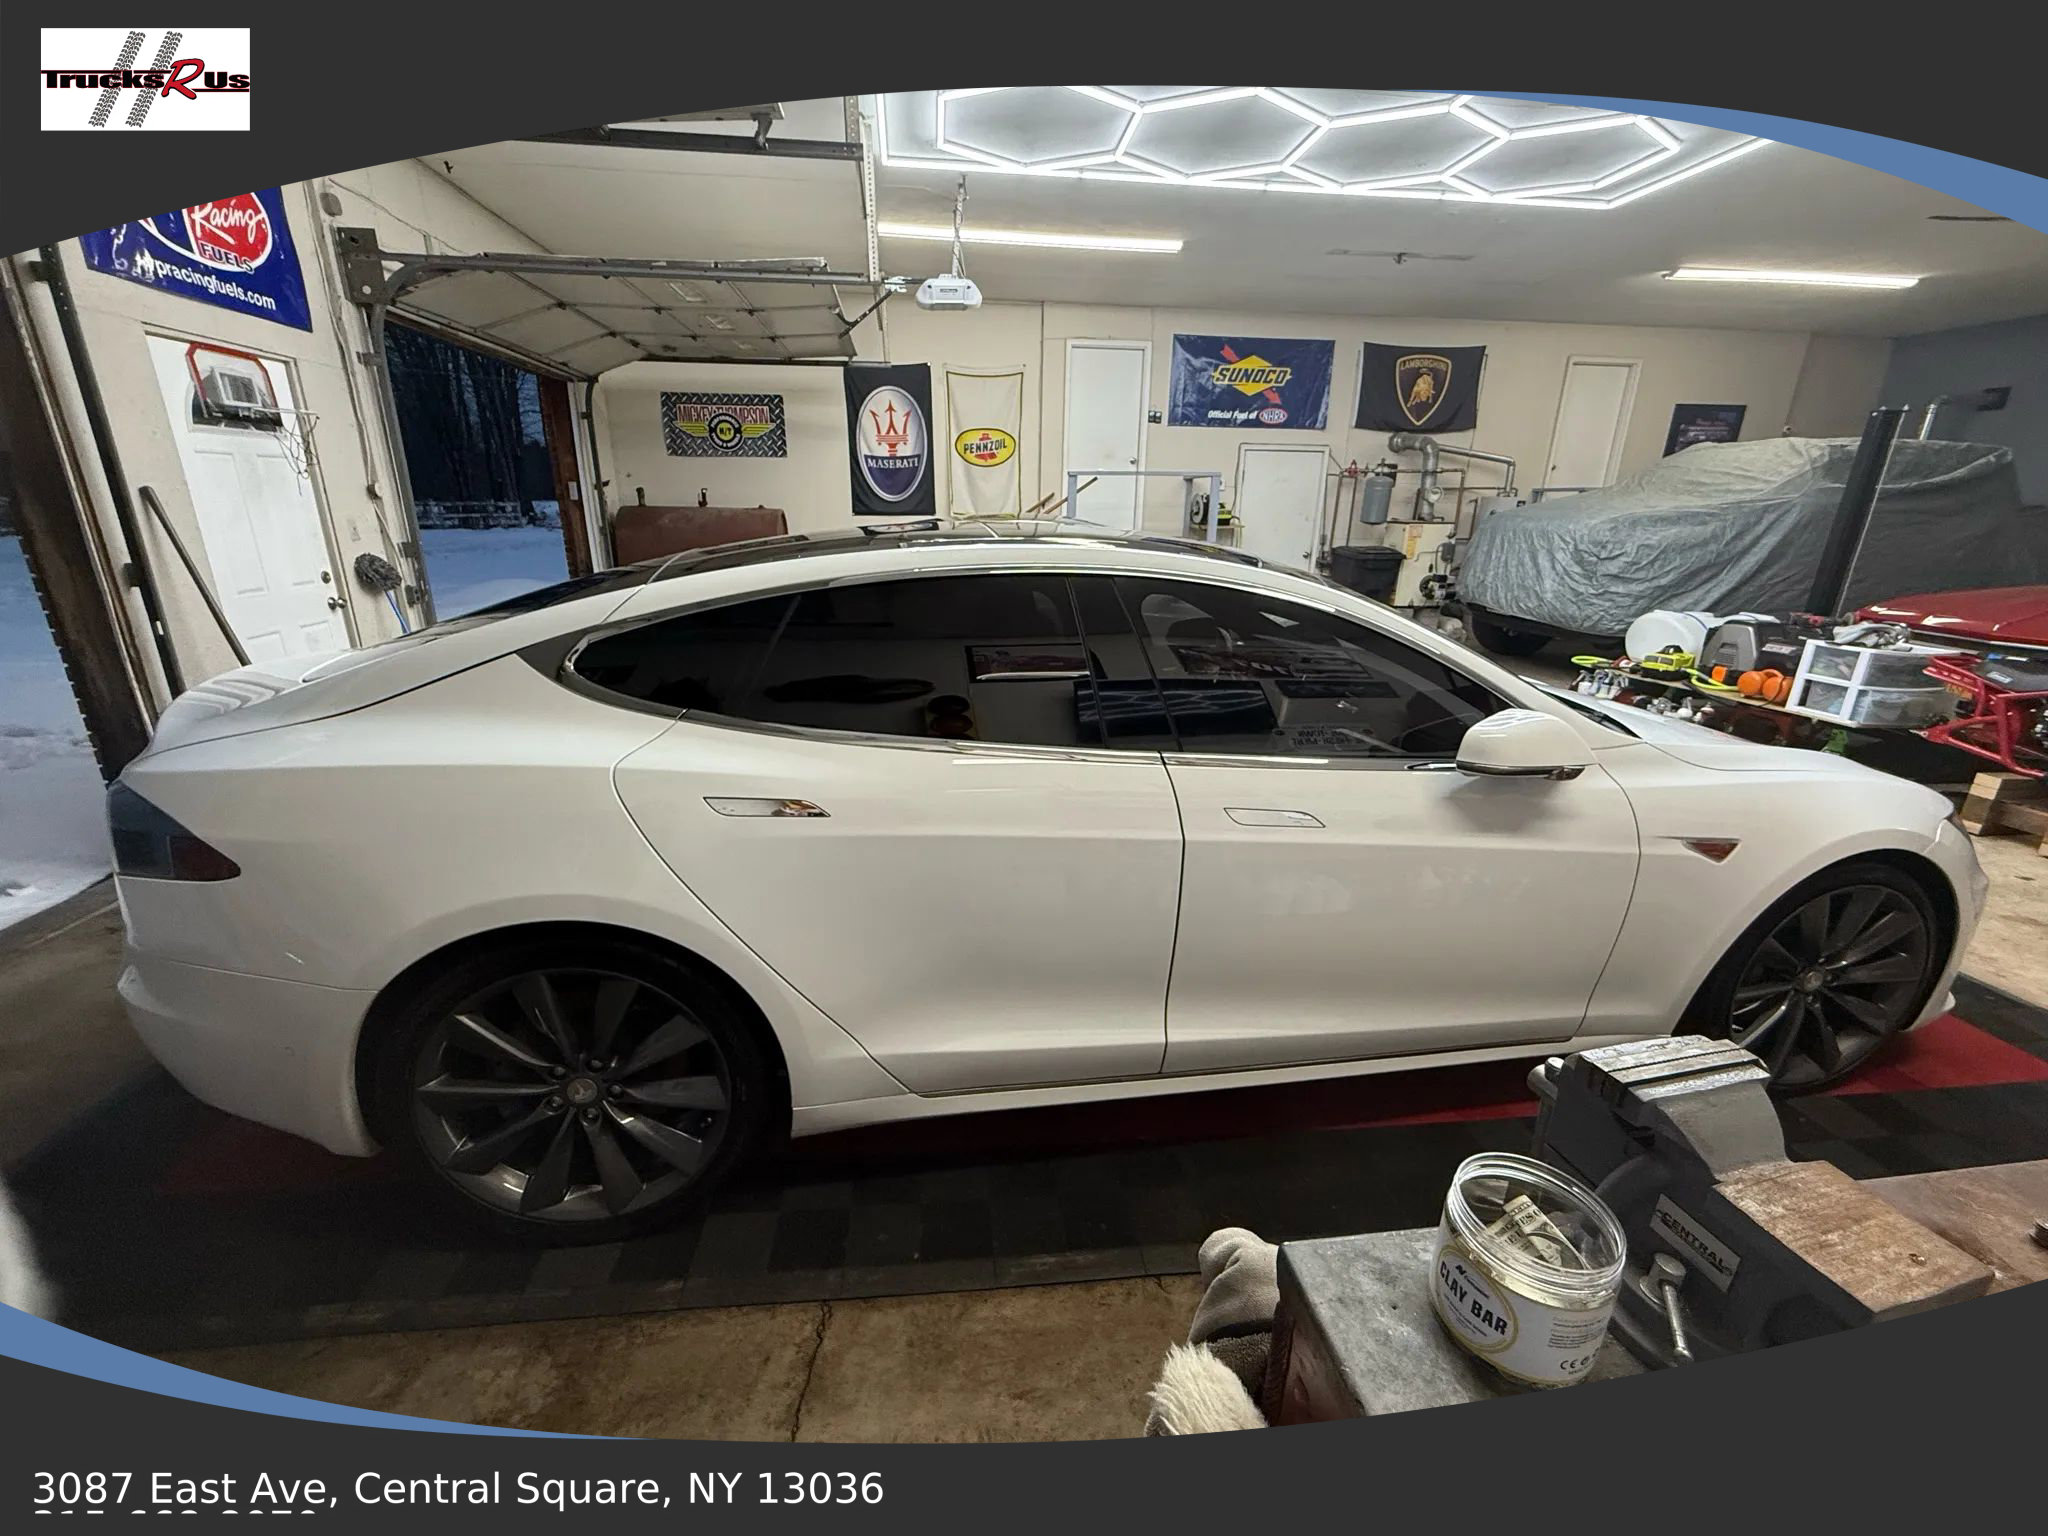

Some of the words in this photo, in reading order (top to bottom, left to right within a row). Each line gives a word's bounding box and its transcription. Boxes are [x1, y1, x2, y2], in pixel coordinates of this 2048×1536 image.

[191, 199, 264, 245] Racing
[198, 240, 255, 275] FUELS
[1399, 357, 1449, 371] LAMBORGHINI
[1215, 367, 1288, 385] SUNOCO
[676, 404, 714, 423] MICKEY
[715, 404, 771, 425] THOMPSON
[1207, 409, 1233, 419] Official
[1233, 408, 1248, 420] Fuel
[1248, 409, 1259, 419] of
[1263, 409, 1284, 421] NHRA
[963, 438, 1008, 455] PENNZOIL
[867, 456, 919, 469] MASERATI
[1661, 1211, 1727, 1271] CENTRAL
[1439, 1260, 1468, 1303] CLAY
[1470, 1299, 1508, 1337] BAR
